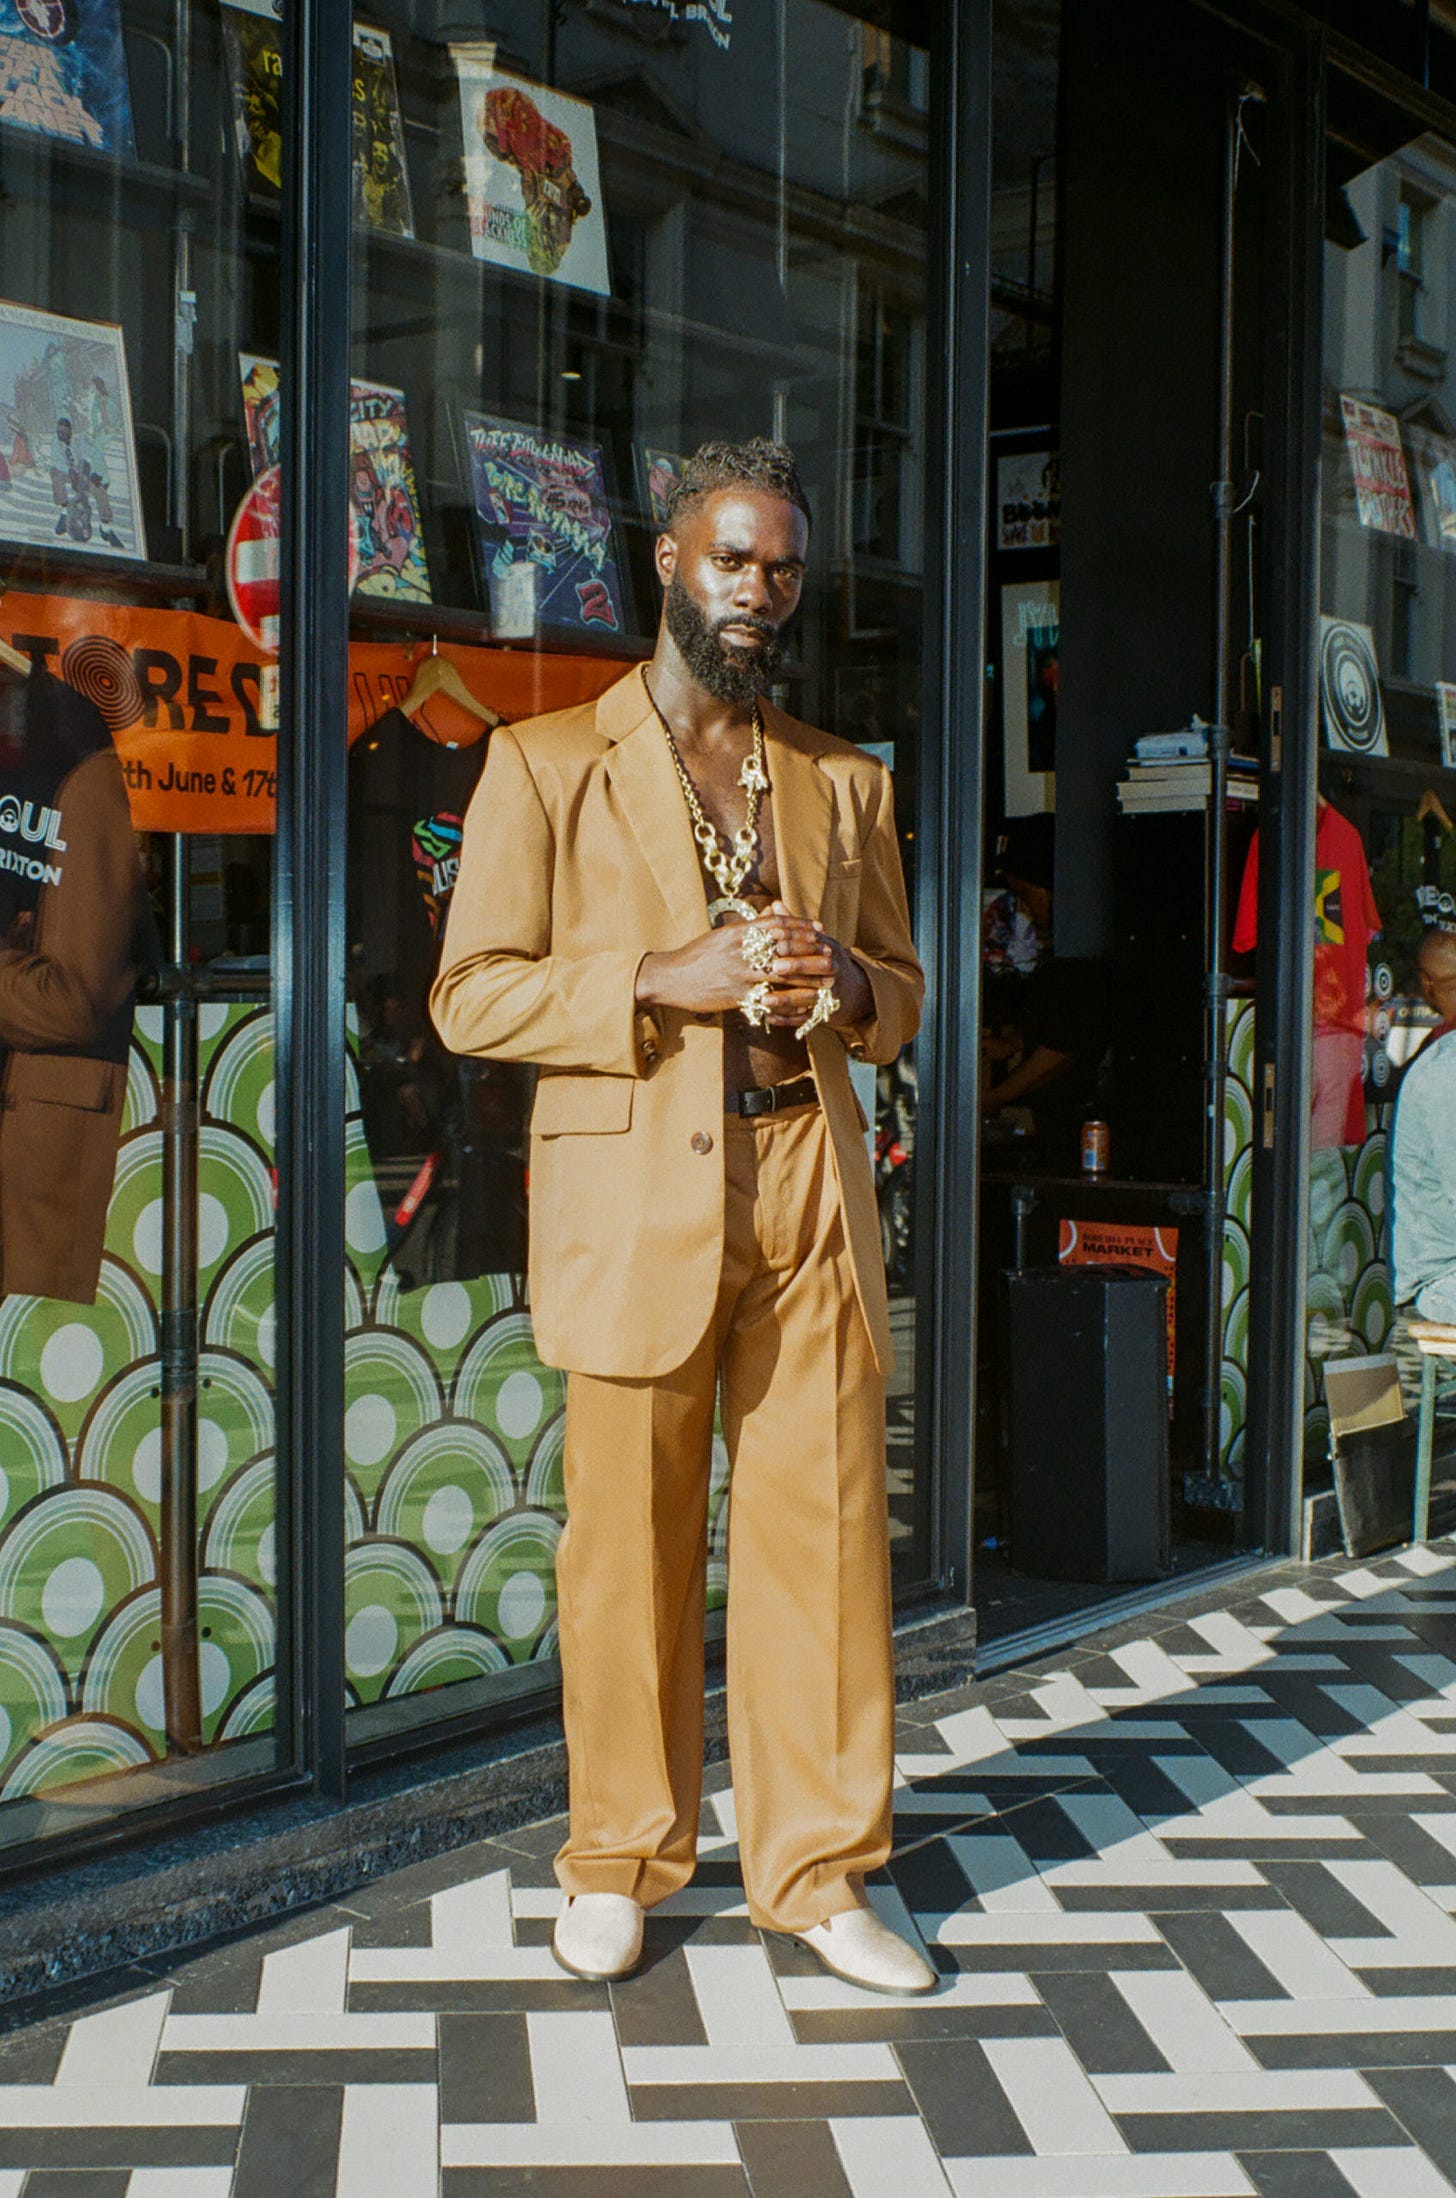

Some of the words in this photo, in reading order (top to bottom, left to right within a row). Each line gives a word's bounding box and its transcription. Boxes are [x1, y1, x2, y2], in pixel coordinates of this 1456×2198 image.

[122, 760, 152, 790] th
[158, 763, 216, 794] June
[221, 768, 237, 796] &
[242, 769, 279, 798] 17t
[0, 794, 67, 852] OUL
[1082, 1242, 1154, 1257] MARKET
